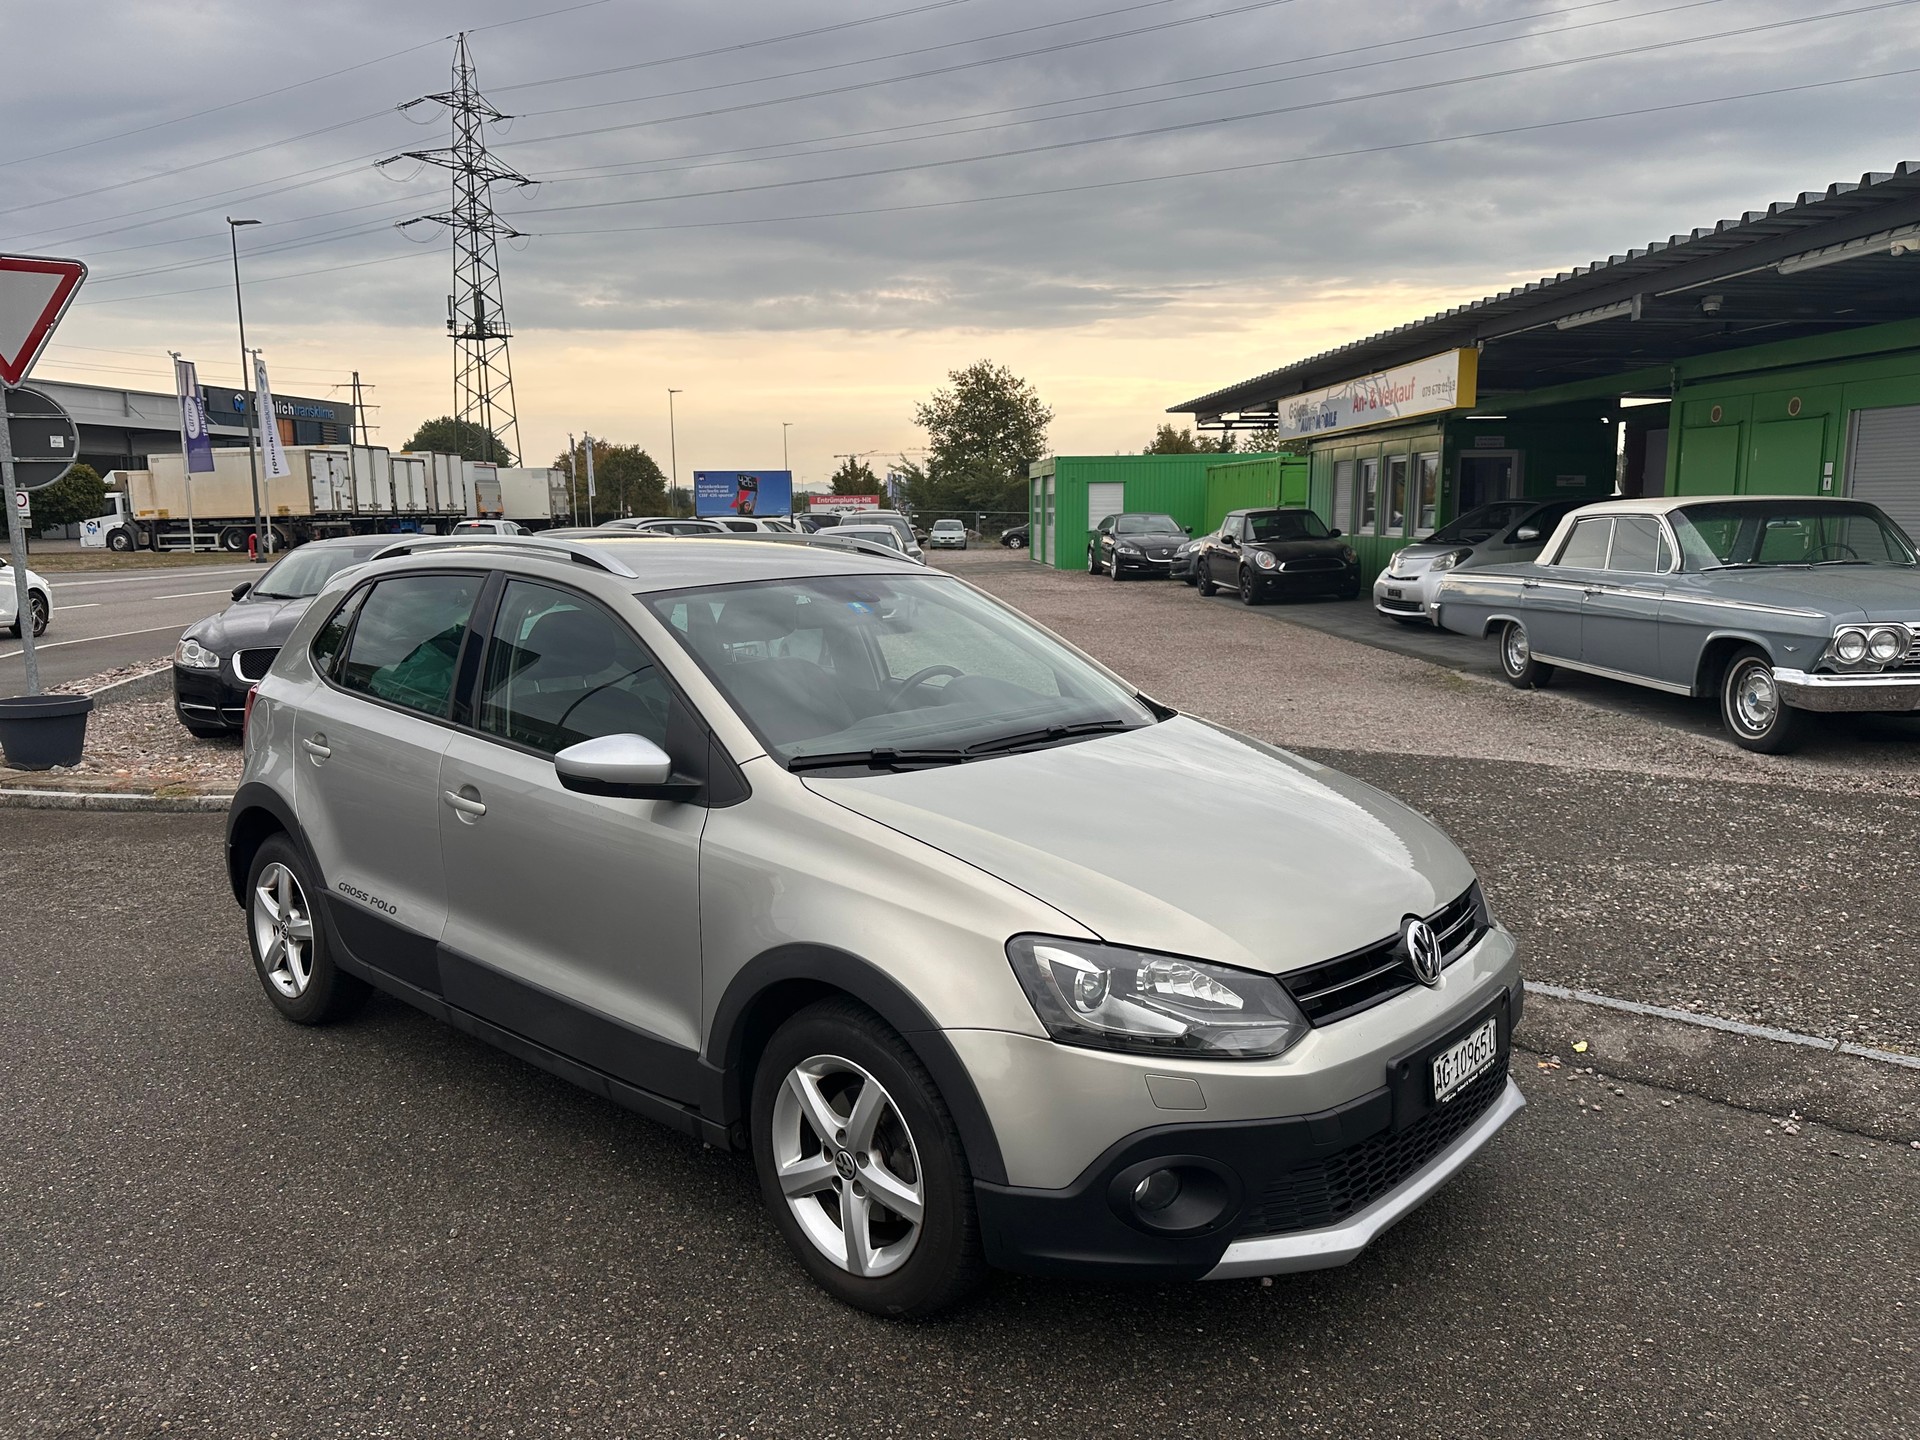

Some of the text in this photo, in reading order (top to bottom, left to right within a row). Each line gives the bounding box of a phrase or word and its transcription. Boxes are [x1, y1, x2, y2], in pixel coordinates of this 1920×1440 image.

[1369, 387, 1377, 409] &
[1379, 376, 1416, 407] Verkauf
[338, 882, 397, 915] CROSS POLO
